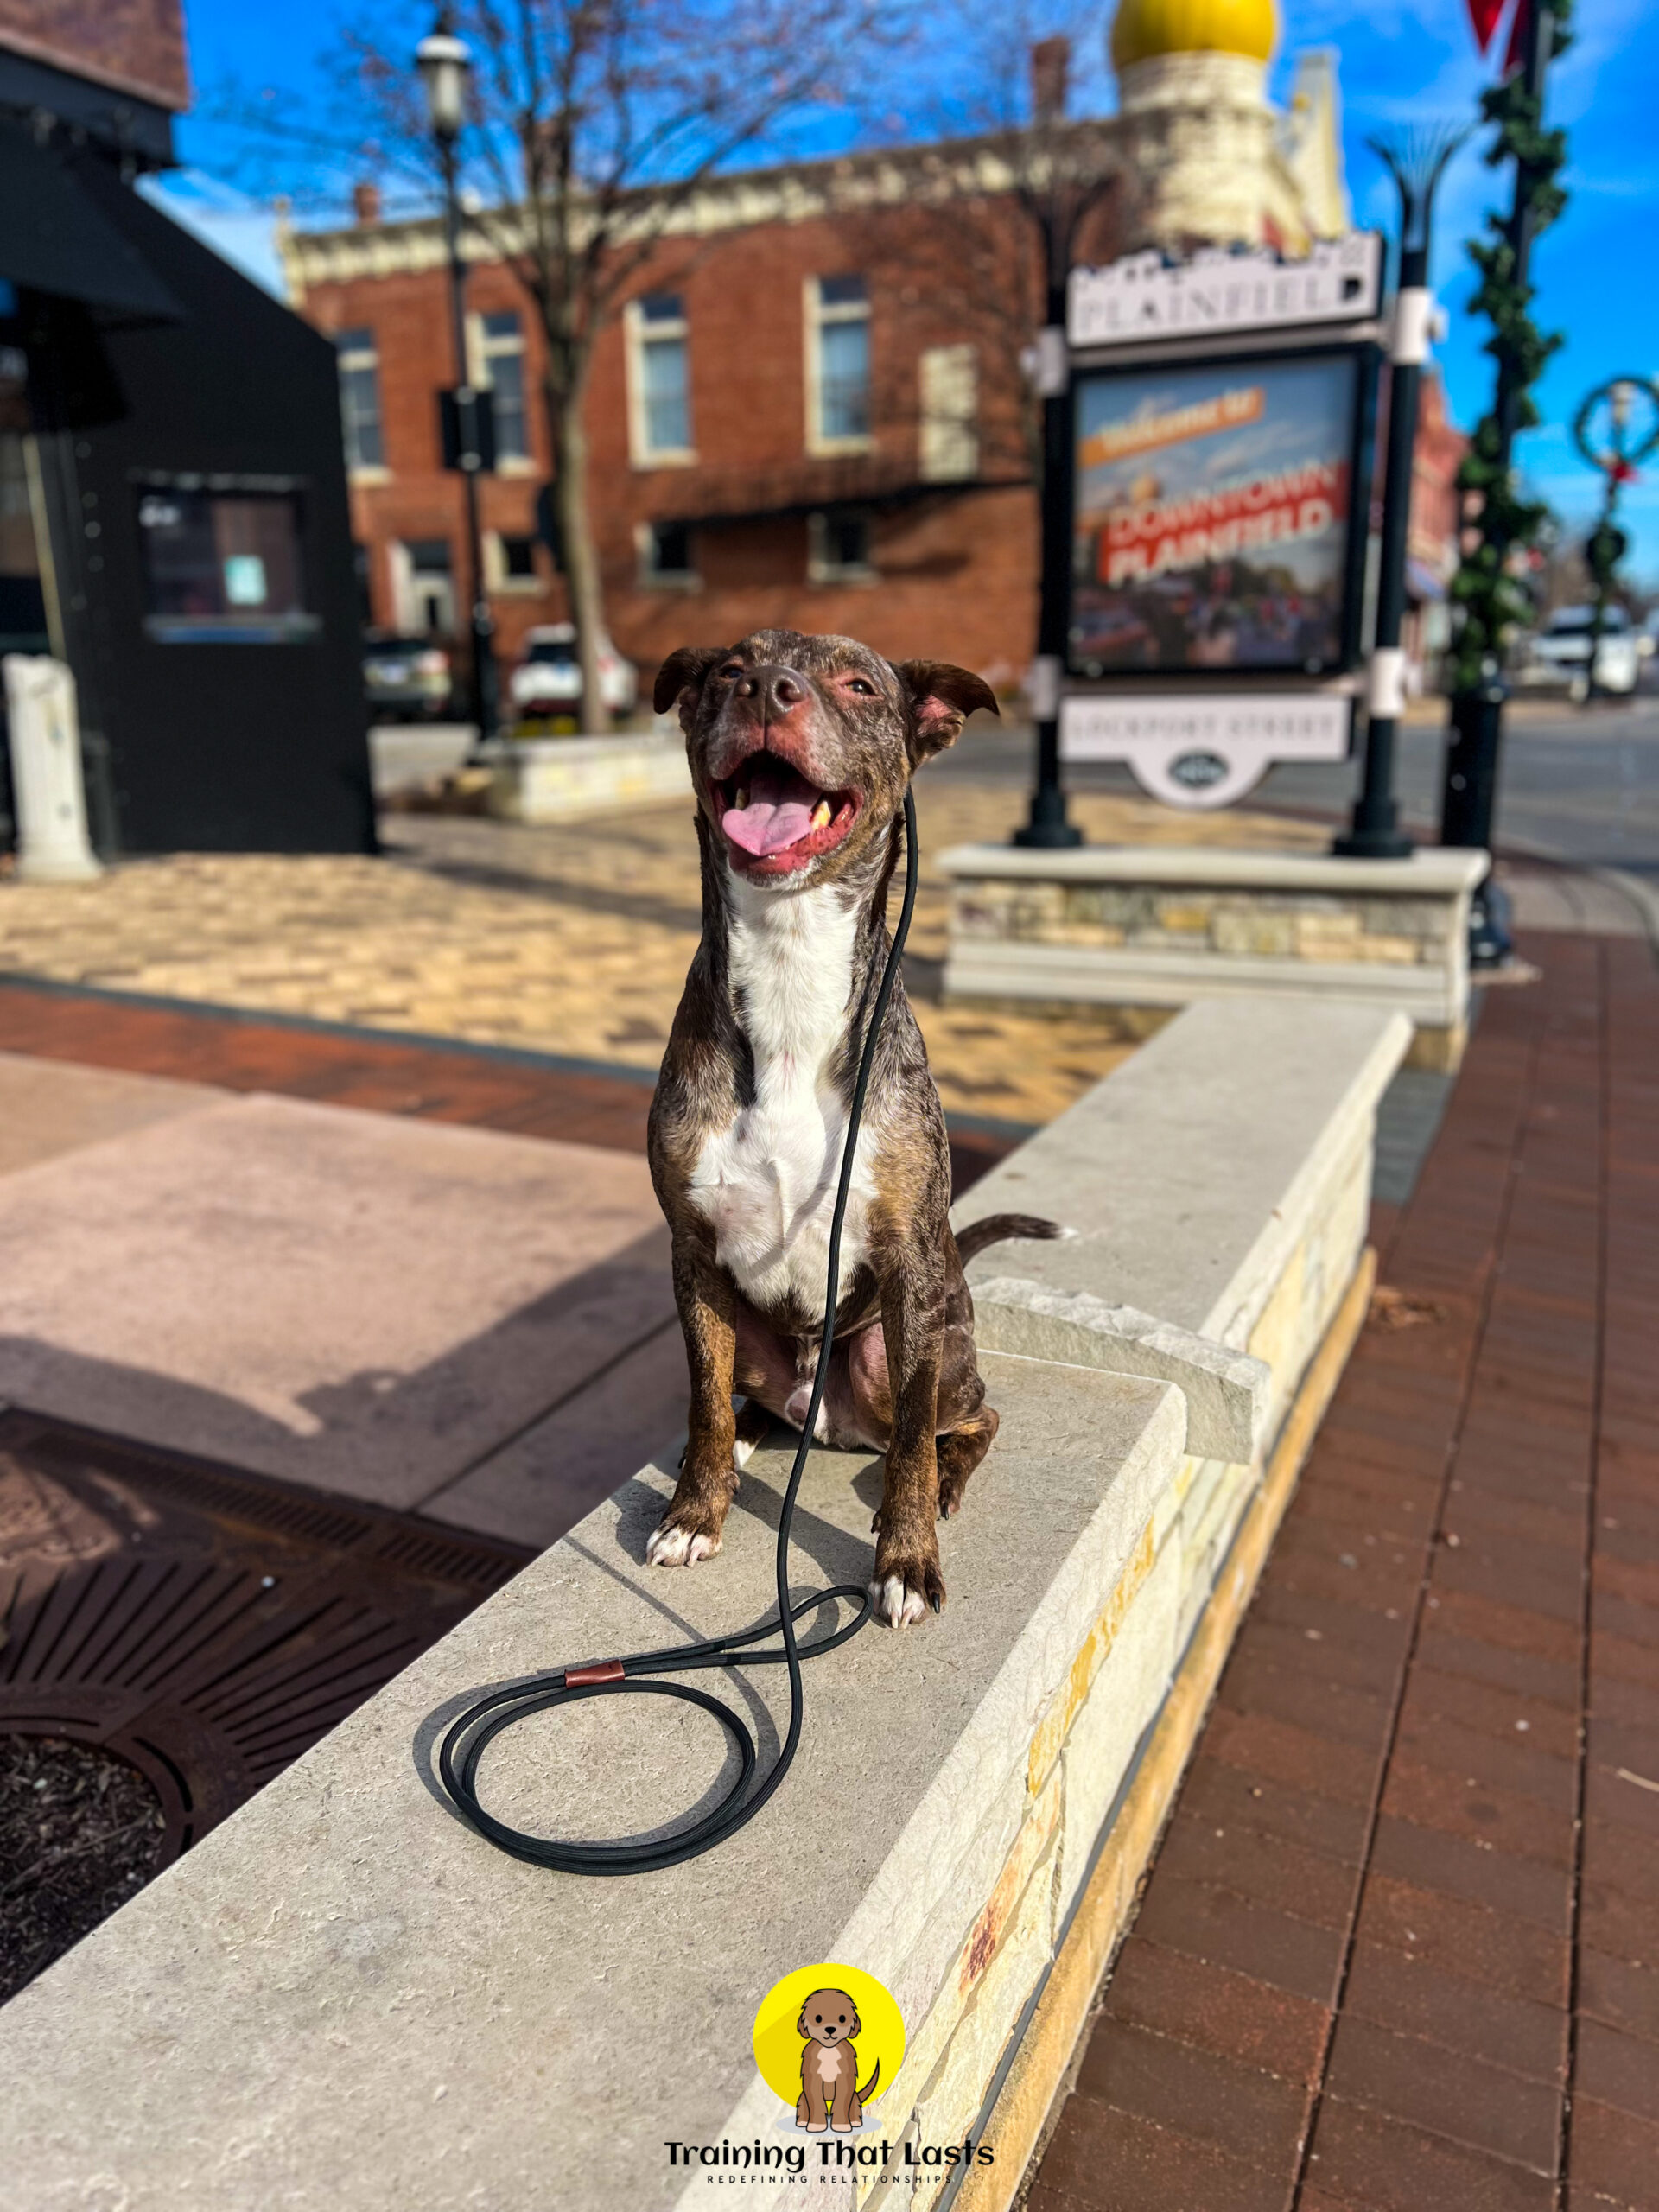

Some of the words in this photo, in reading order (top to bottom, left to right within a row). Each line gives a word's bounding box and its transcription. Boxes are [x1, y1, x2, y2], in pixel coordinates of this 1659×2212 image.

[1079, 272, 1364, 332] PLAINFIELD
[1100, 397, 1219, 450] Welcome
[1222, 387, 1255, 420] to
[1109, 459, 1334, 545] DOWNTOWN
[1109, 499, 1332, 588] PLAINFIELD
[1071, 713, 1219, 740] LOCKPORT
[1229, 712, 1334, 738] STREET
